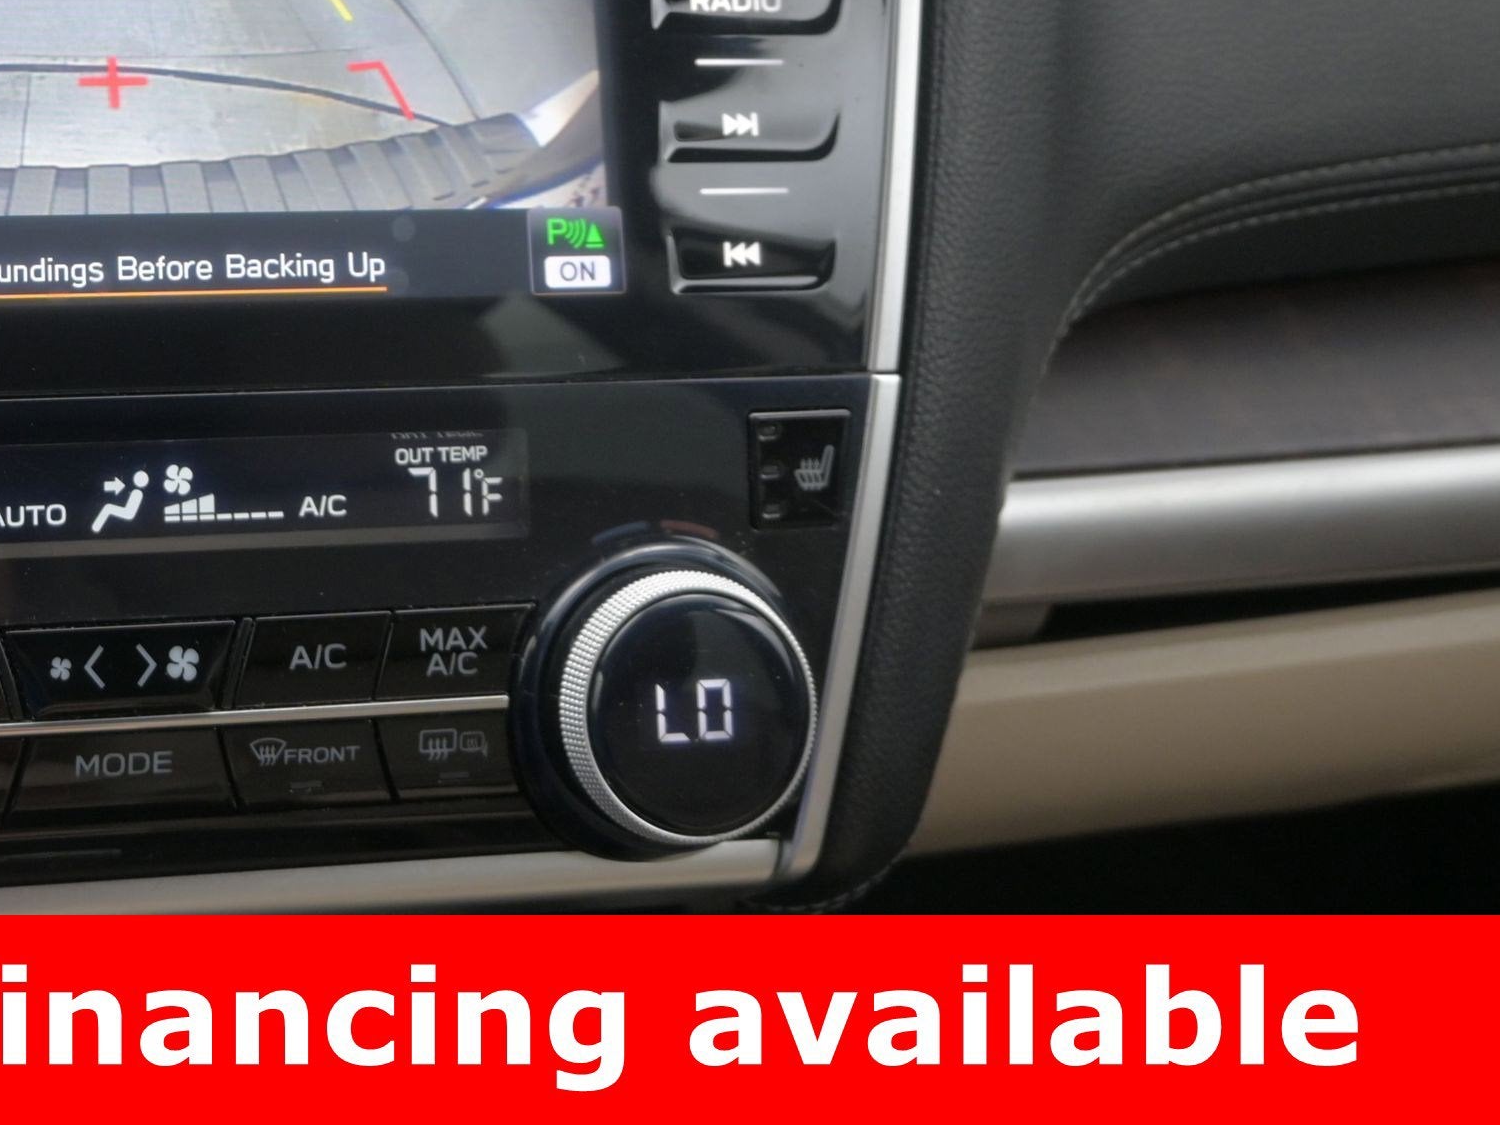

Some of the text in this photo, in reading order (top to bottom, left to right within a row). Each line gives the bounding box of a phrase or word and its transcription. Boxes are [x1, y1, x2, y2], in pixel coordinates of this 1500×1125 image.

[117, 256, 213, 281] Before
[225, 253, 335, 283] Backing
[348, 251, 386, 282] Up
[559, 261, 597, 282] ON
[395, 445, 488, 465] OUT TEMP
[299, 495, 347, 517] A/C
[419, 626, 488, 652] MAX
[289, 644, 347, 670] A/C
[426, 652, 478, 676] A/C
[75, 750, 174, 777] MODE
[283, 745, 360, 764] FRONT
